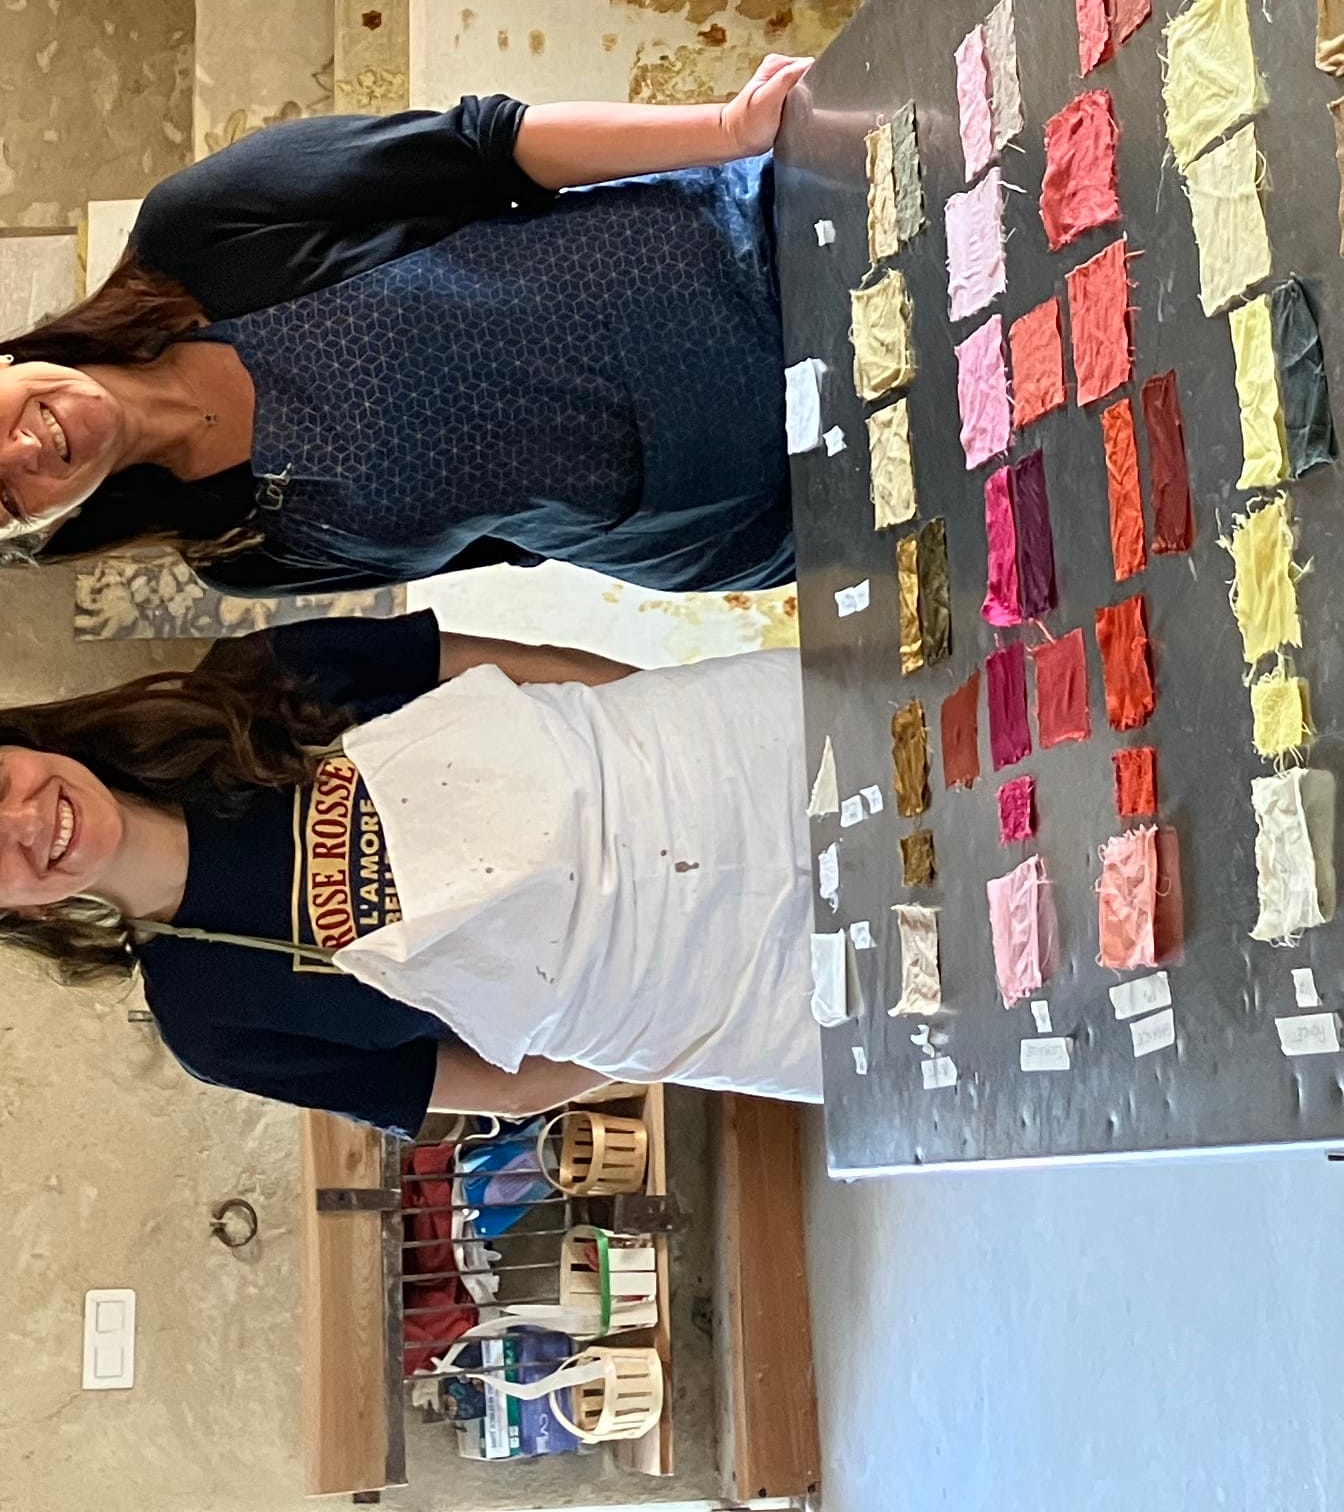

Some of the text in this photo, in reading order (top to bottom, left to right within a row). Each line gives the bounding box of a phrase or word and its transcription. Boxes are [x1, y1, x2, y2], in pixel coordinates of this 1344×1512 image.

[311, 759, 356, 948] ROSE ROSSE
[359, 798, 379, 925] L'AMORE
